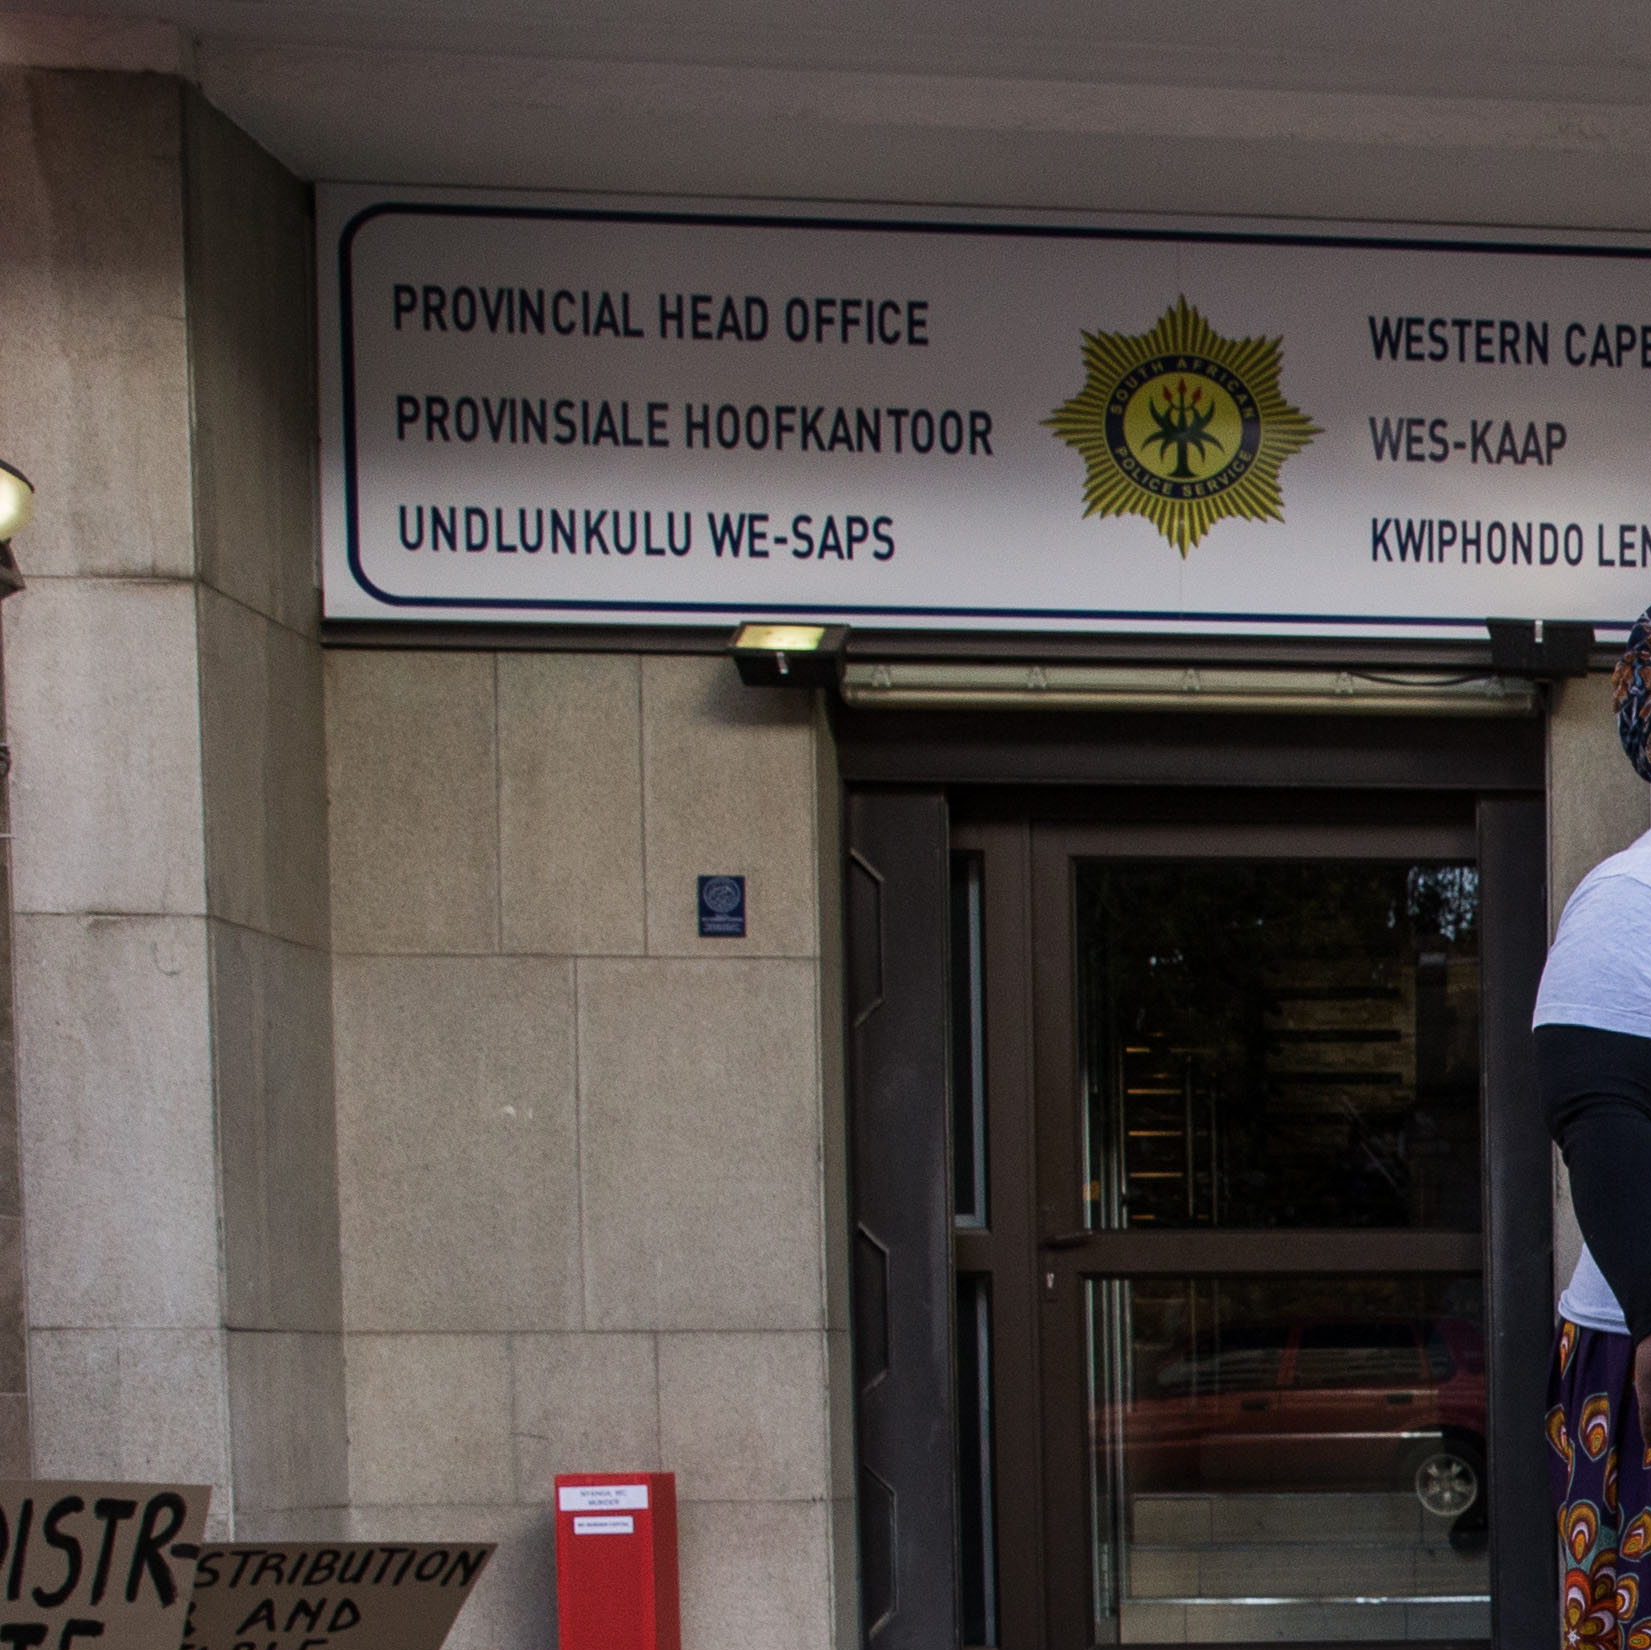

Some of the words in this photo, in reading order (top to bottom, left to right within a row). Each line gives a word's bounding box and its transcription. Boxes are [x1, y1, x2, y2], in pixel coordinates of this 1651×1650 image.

[393, 284, 644, 338] PROVINCIAL
[658, 293, 769, 342] HEAD
[784, 299, 929, 346] OFFICE
[1369, 315, 1550, 366] WESTERN
[1109, 360, 1165, 415] SOUTH
[1175, 357, 1255, 419] AFRICAN
[395, 394, 670, 448] PROVINSIALE
[684, 403, 994, 457] HOOFKANTOOR
[1369, 415, 1568, 466] WES-KAAP
[1114, 446, 1173, 496] POLICE
[1182, 451, 1252, 498] SERVICE
[398, 505, 693, 556] UNDLUNKULU
[708, 512, 897, 561] WE-SAPS
[1371, 517, 1584, 567] KWIPHONDO
[0, 1492, 199, 1608] ISTR-
[236, 1598, 361, 1635] AND
